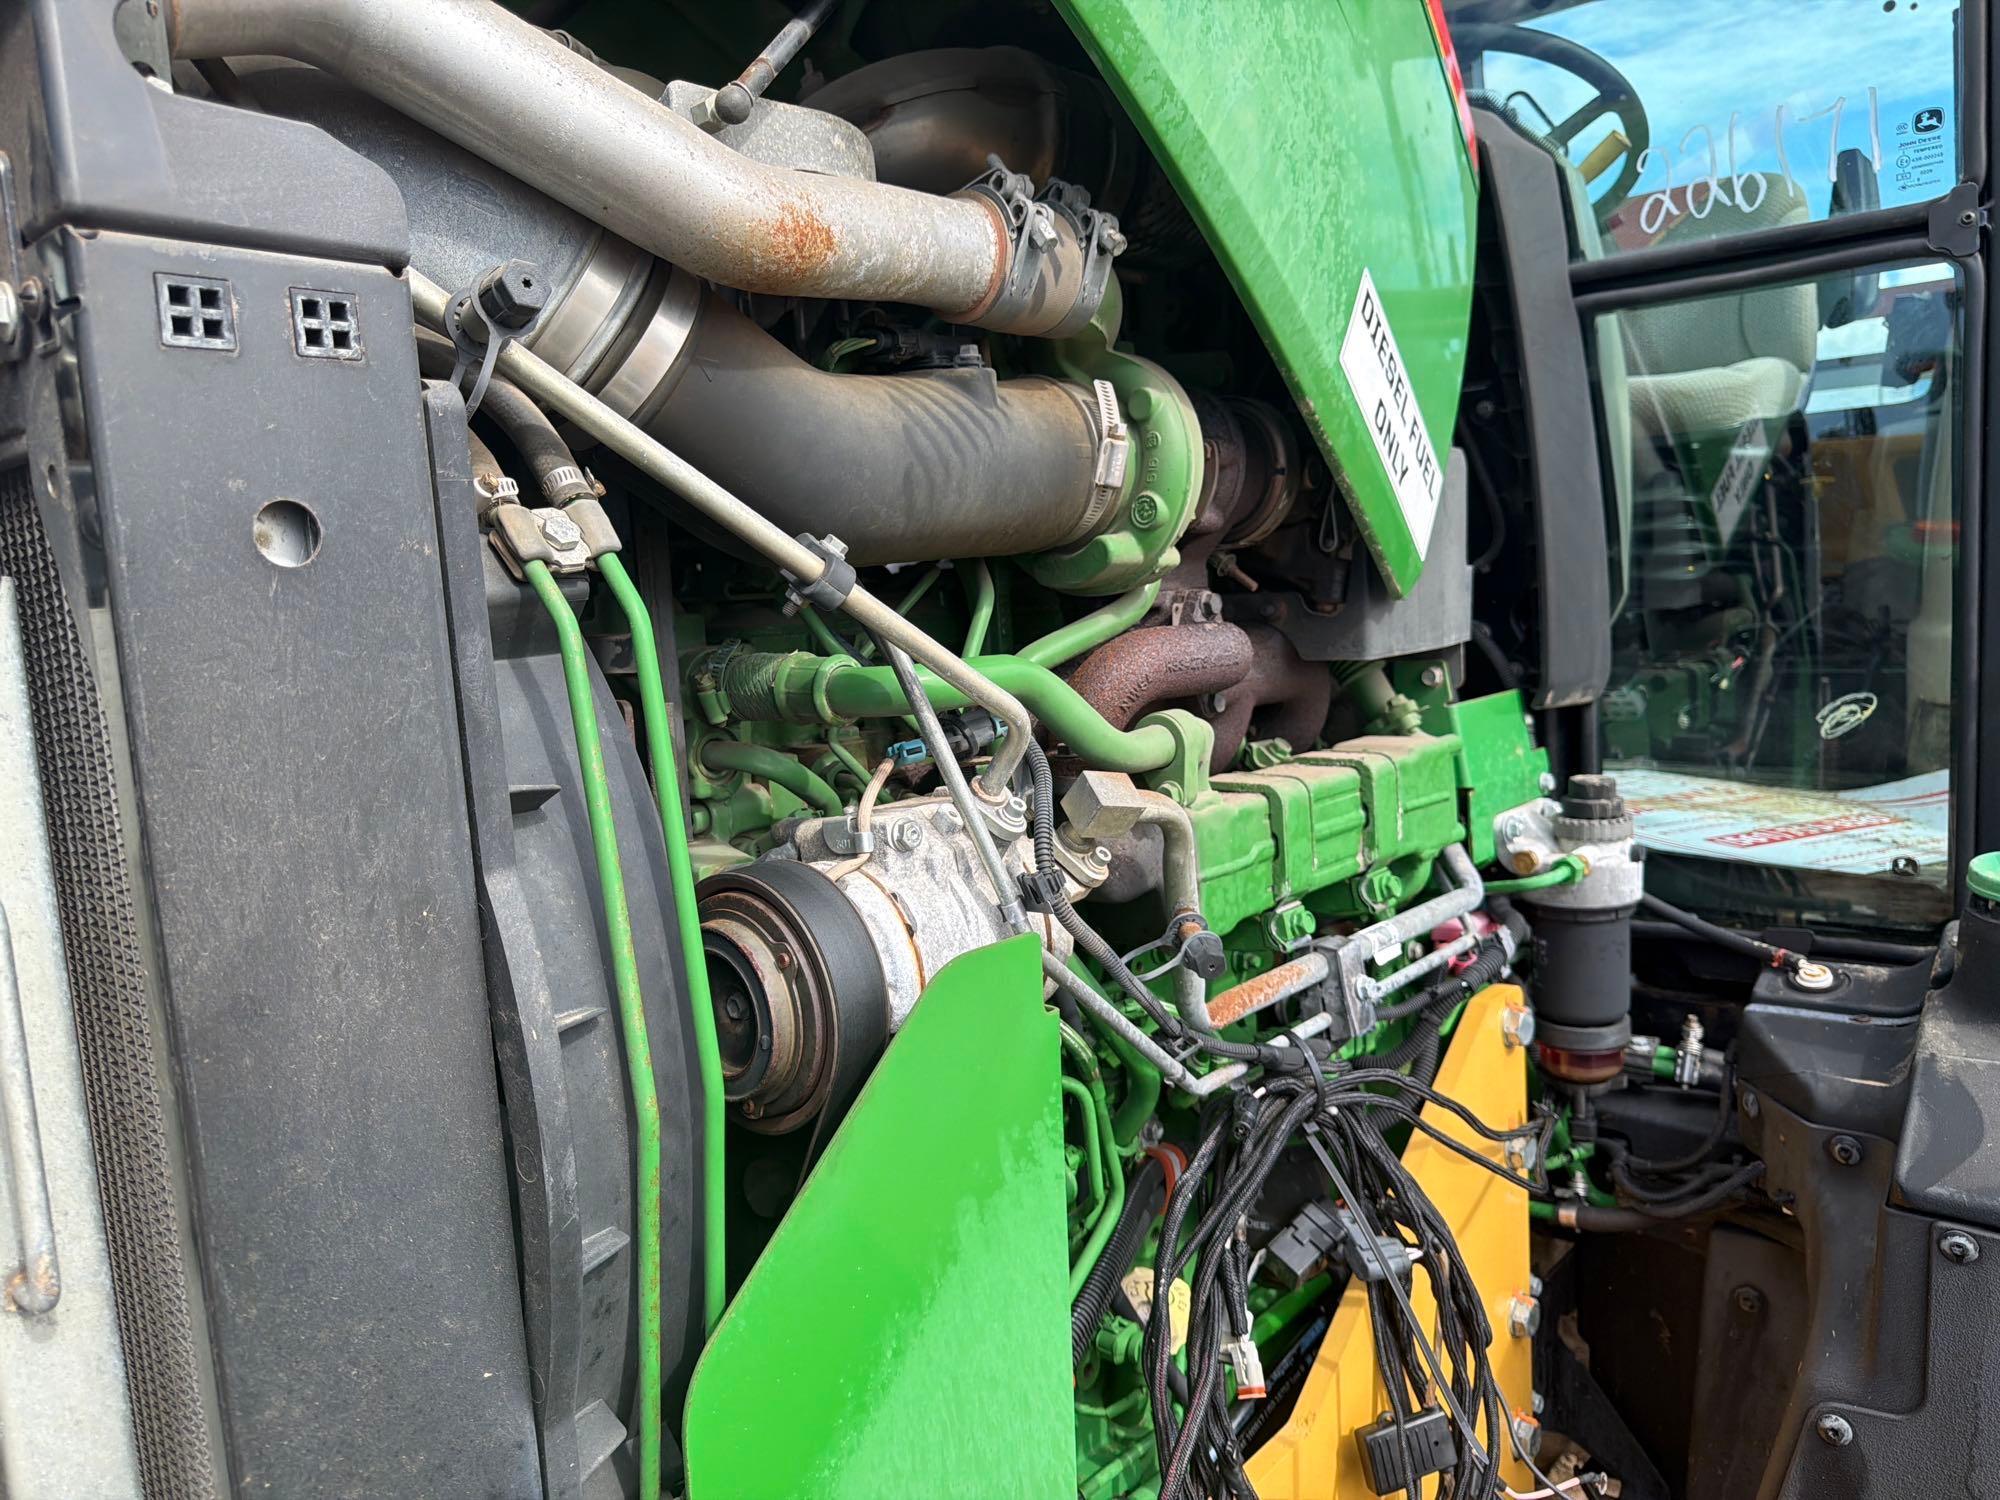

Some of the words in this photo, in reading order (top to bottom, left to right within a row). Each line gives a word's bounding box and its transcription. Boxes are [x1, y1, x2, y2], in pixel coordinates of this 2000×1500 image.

[1360, 288, 1407, 427] DIESEL
[1408, 419, 1438, 502] FUEL
[1374, 397, 1409, 487] ONLY
